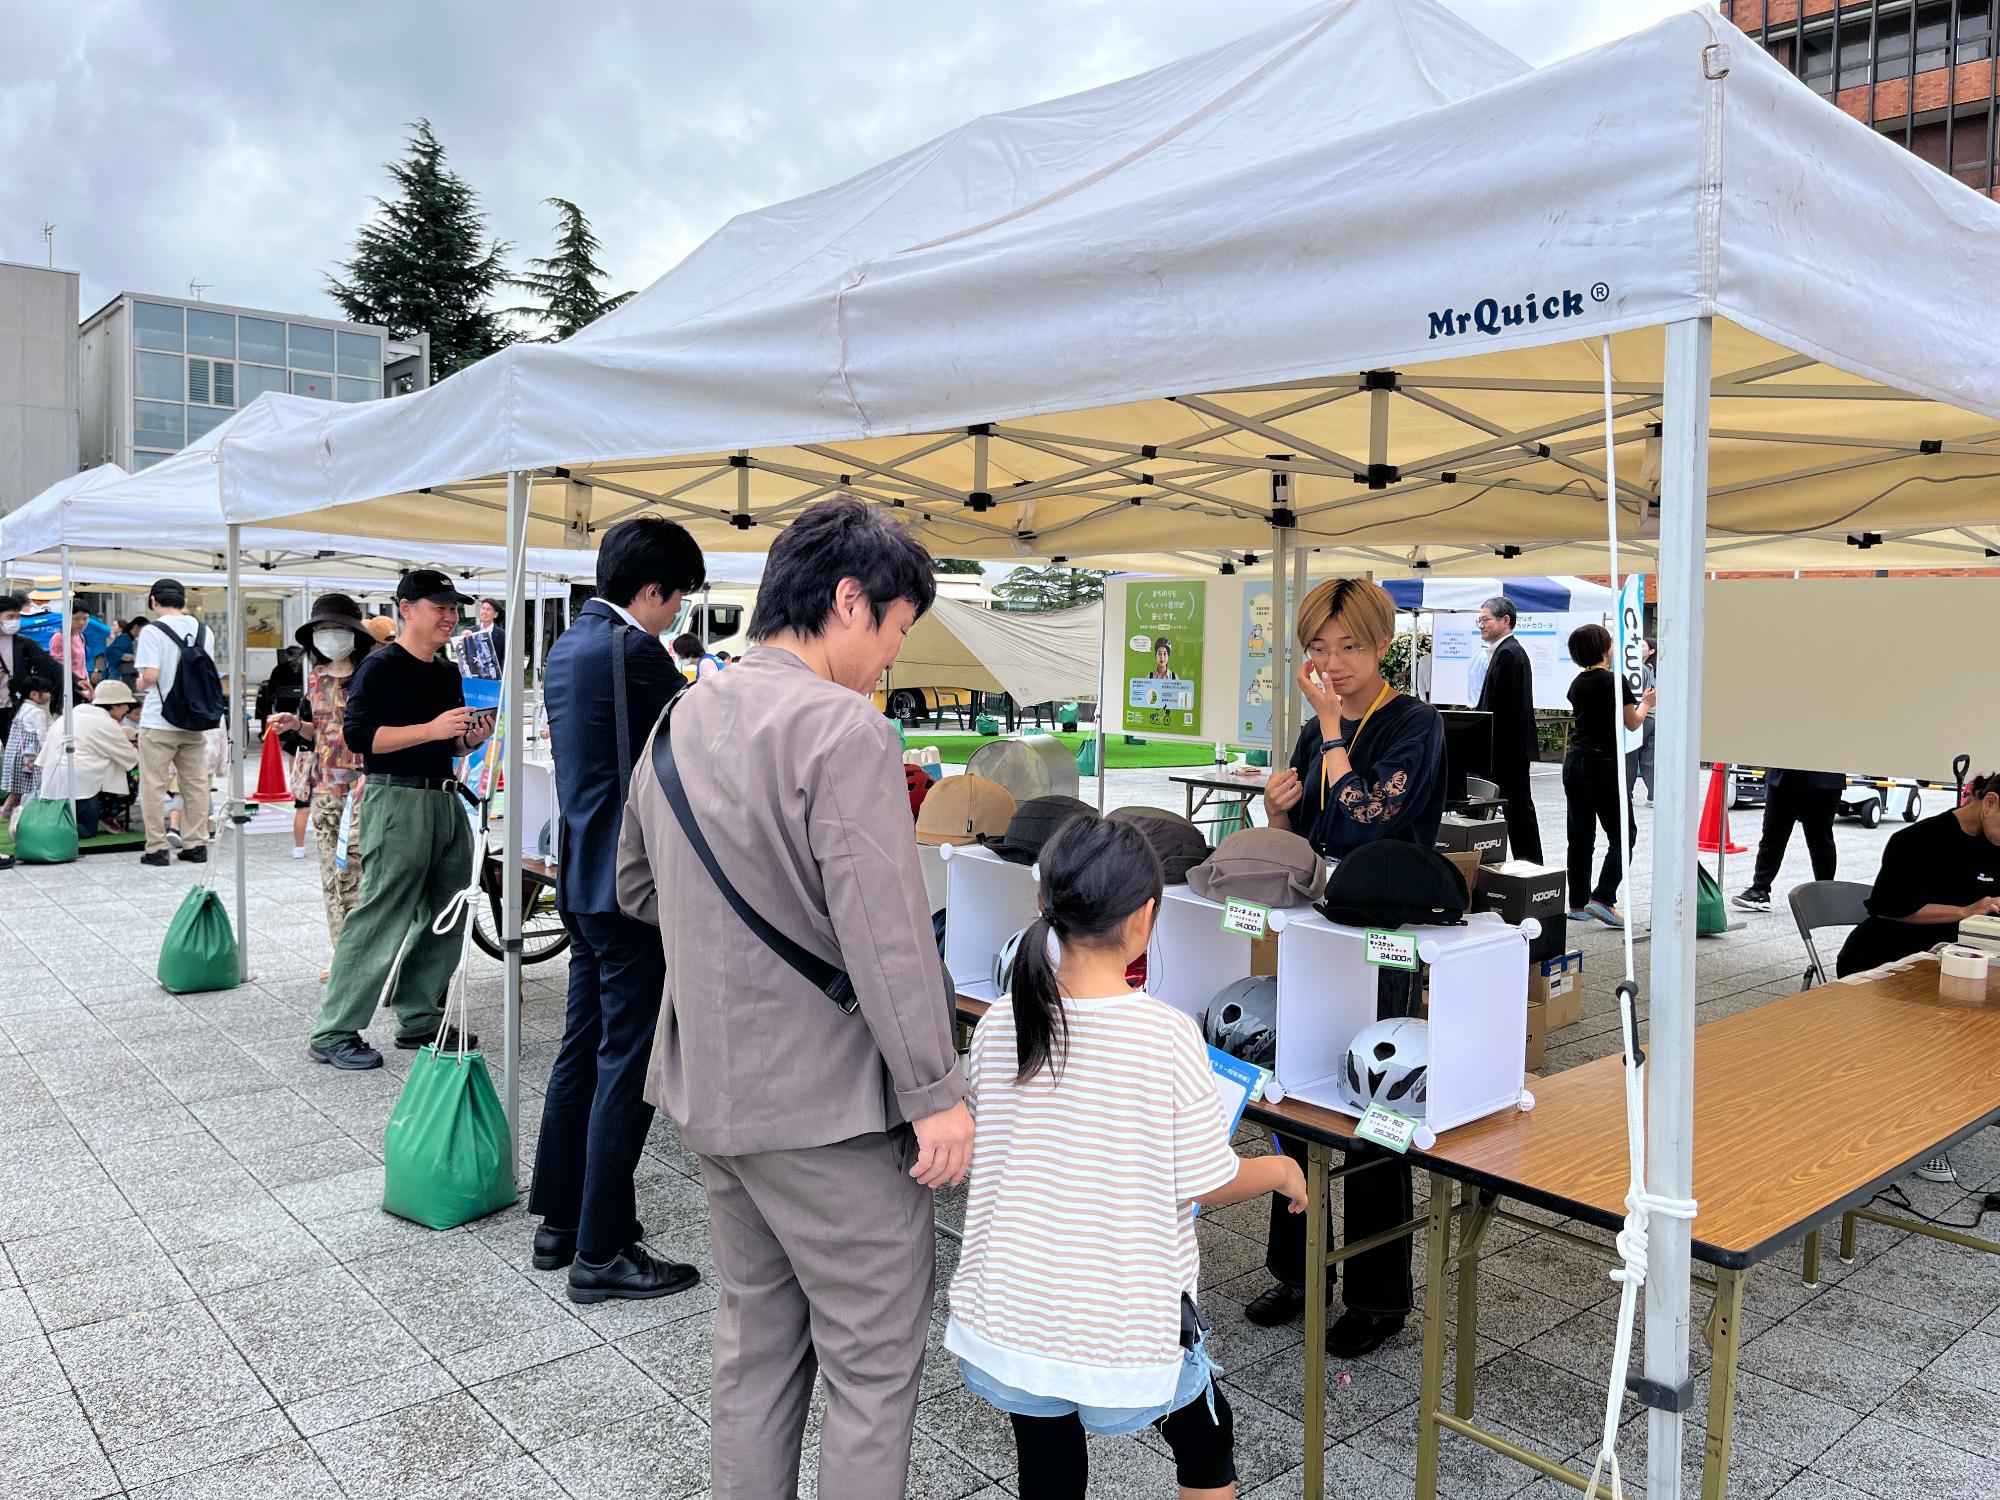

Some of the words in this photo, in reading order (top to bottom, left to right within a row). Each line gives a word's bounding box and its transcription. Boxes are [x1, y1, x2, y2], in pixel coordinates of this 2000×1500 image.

[1428, 289, 1584, 340] MrQuick
[1473, 838, 1502, 851] KOOFU
[1531, 888, 1561, 903] KOOFU
